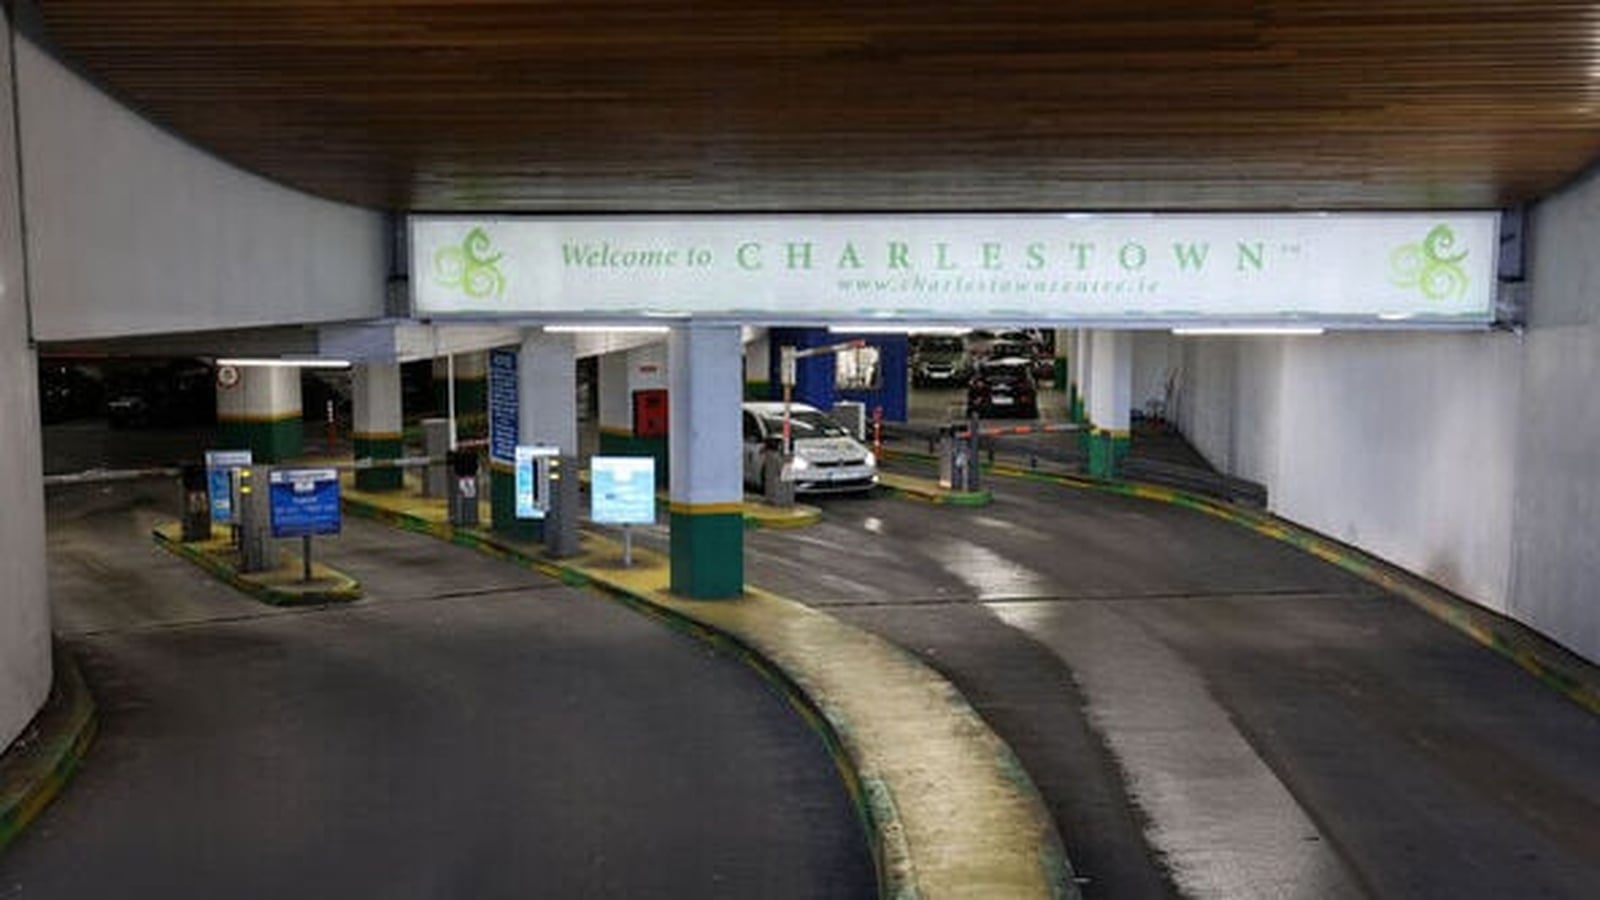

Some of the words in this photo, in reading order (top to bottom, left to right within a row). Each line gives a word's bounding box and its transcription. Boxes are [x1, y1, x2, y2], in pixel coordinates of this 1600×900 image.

[562, 242, 678, 268] Welcome
[688, 247, 712, 267] to
[736, 241, 1266, 271] CHARLESTOWN
